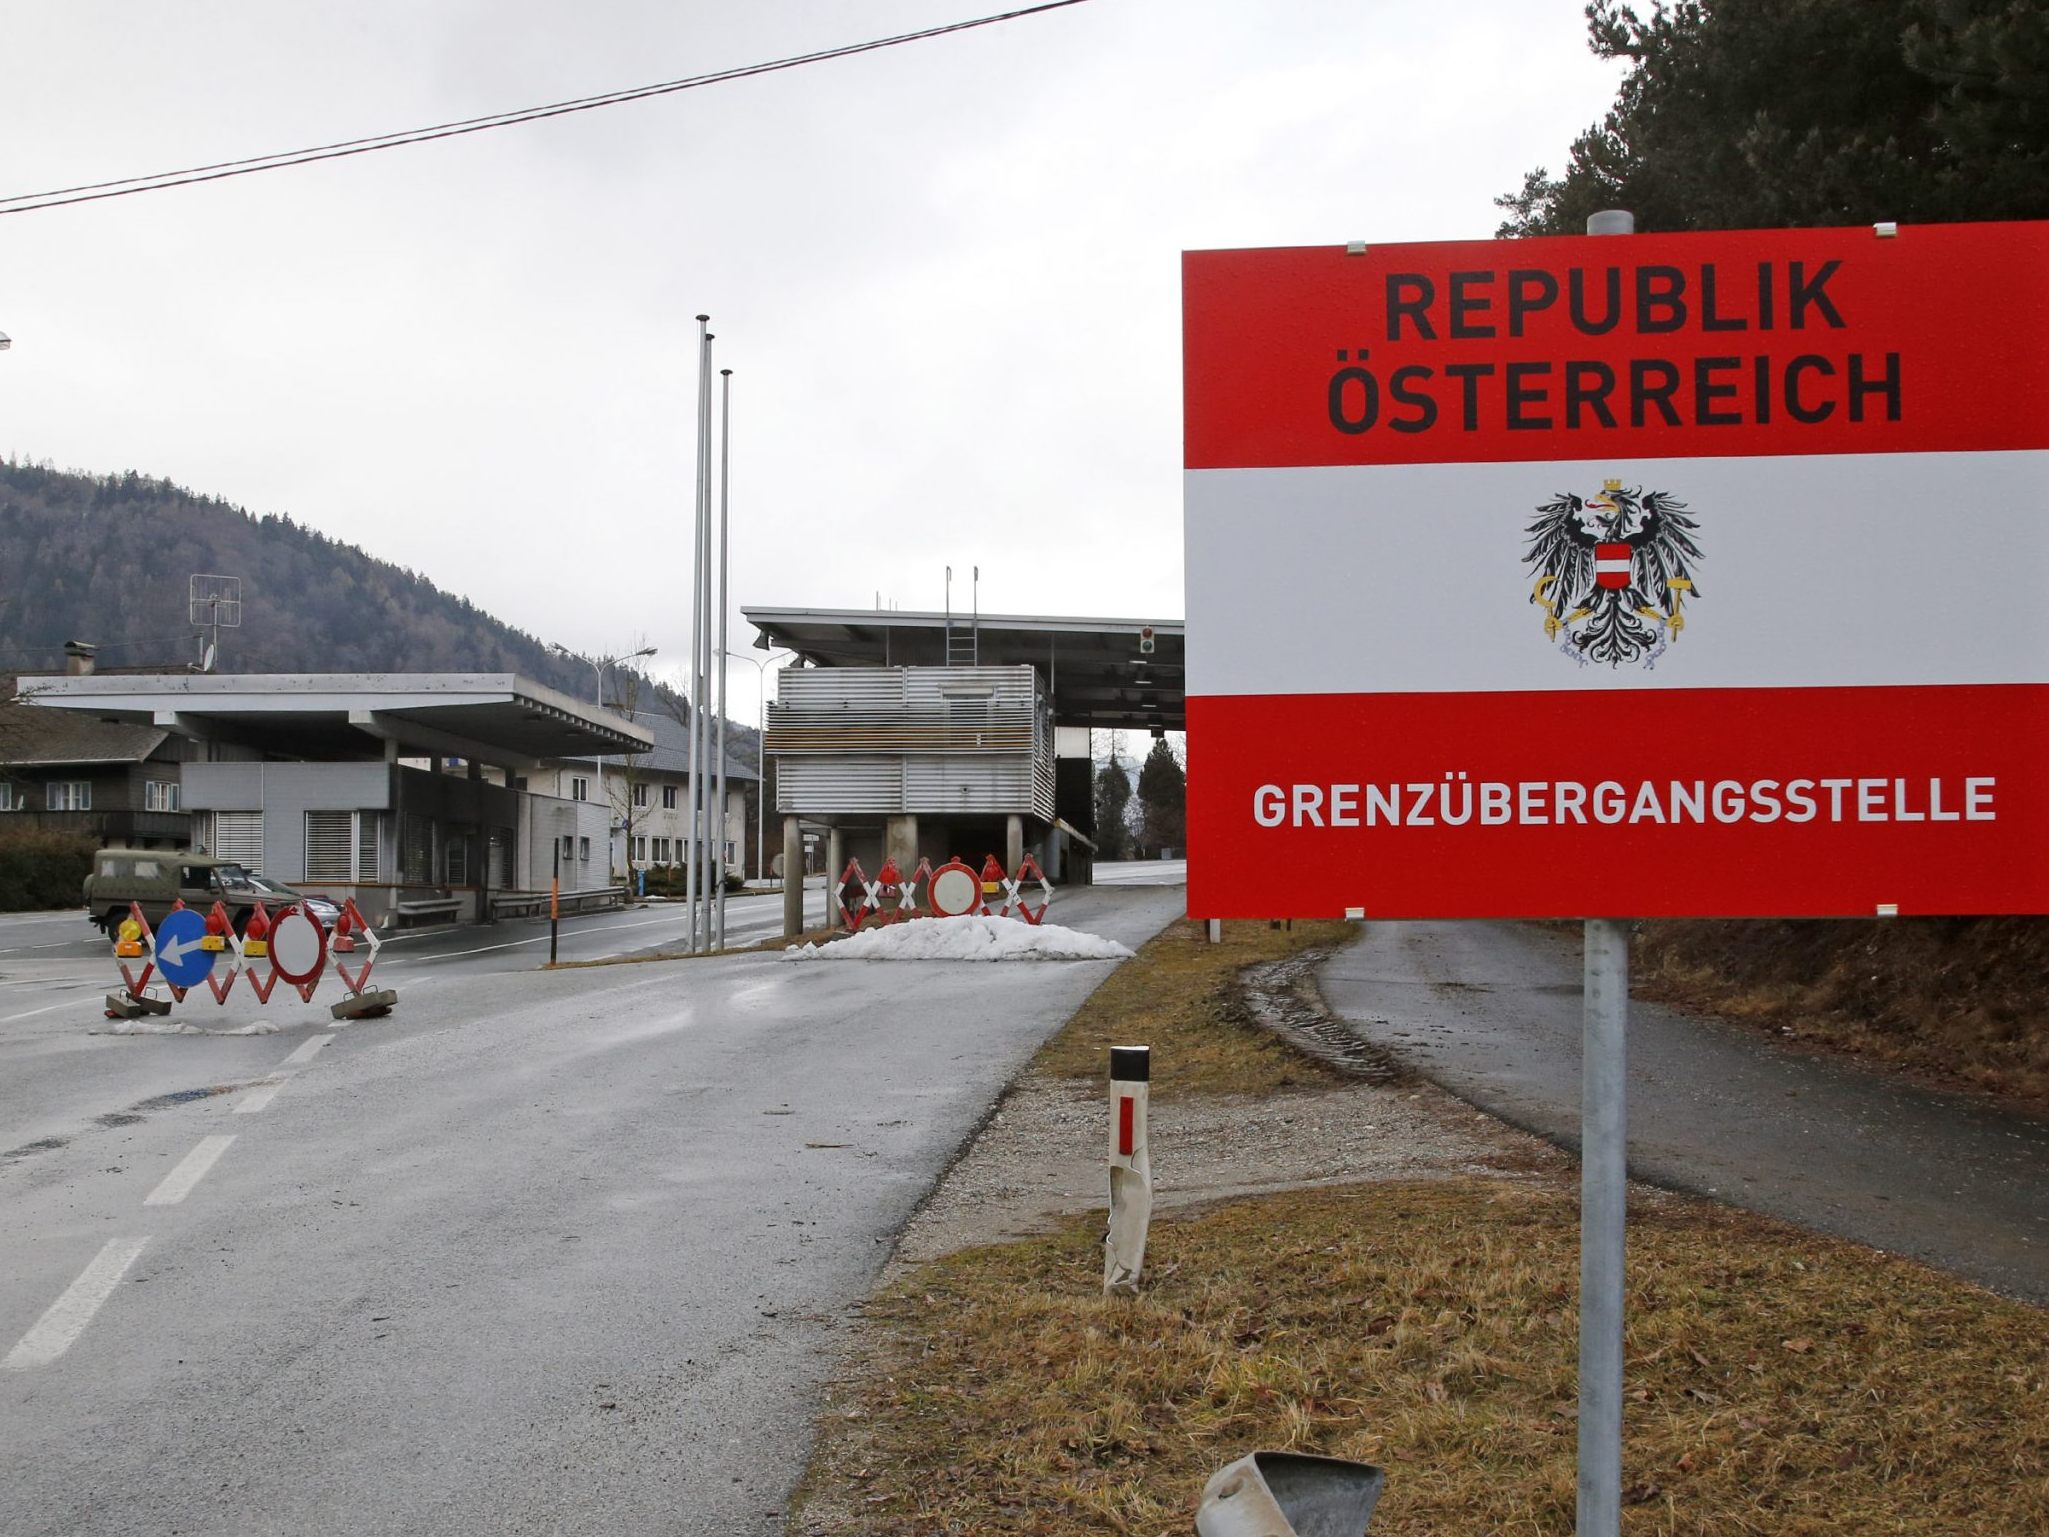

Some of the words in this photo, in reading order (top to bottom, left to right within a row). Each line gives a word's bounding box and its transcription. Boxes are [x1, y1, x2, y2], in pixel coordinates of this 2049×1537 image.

[1386, 260, 1846, 341] REPUBLIK
[1328, 349, 1902, 435] ÖSTERREICH
[1253, 771, 1996, 828] GRENZÜBERGANGSSTELLE
